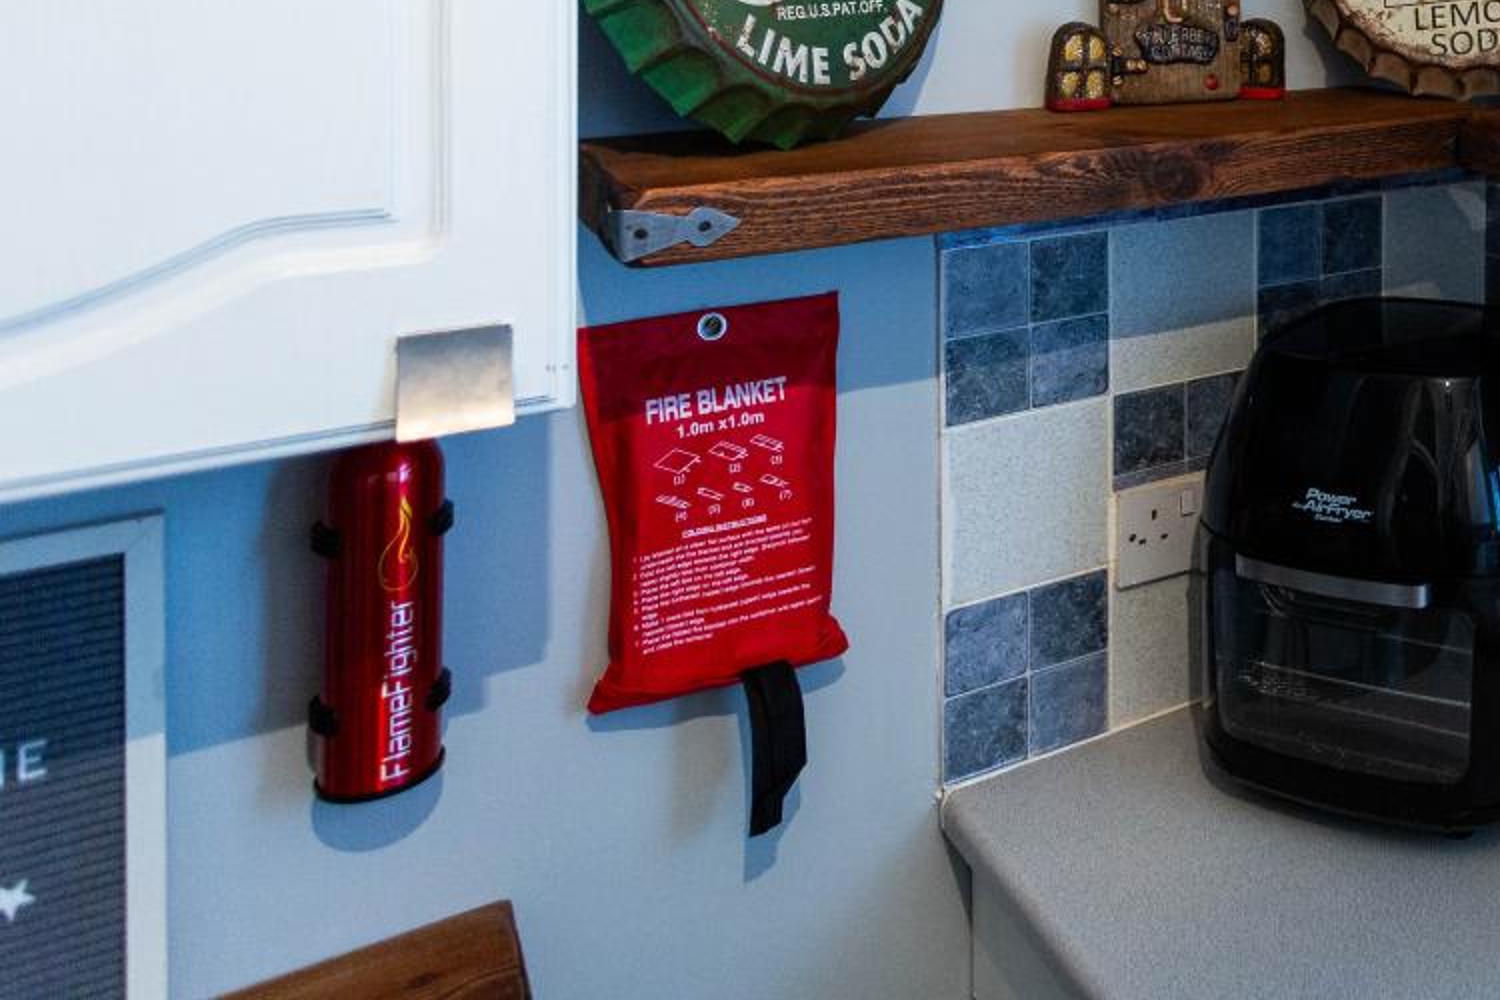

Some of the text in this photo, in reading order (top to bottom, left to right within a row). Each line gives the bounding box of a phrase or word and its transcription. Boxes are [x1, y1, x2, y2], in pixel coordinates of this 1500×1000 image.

[736, 13, 831, 85] LIME
[645, 376, 787, 425] FIRE BLANKET
[676, 421, 714, 438] 1.0m
[1305, 487, 1357, 506] Power
